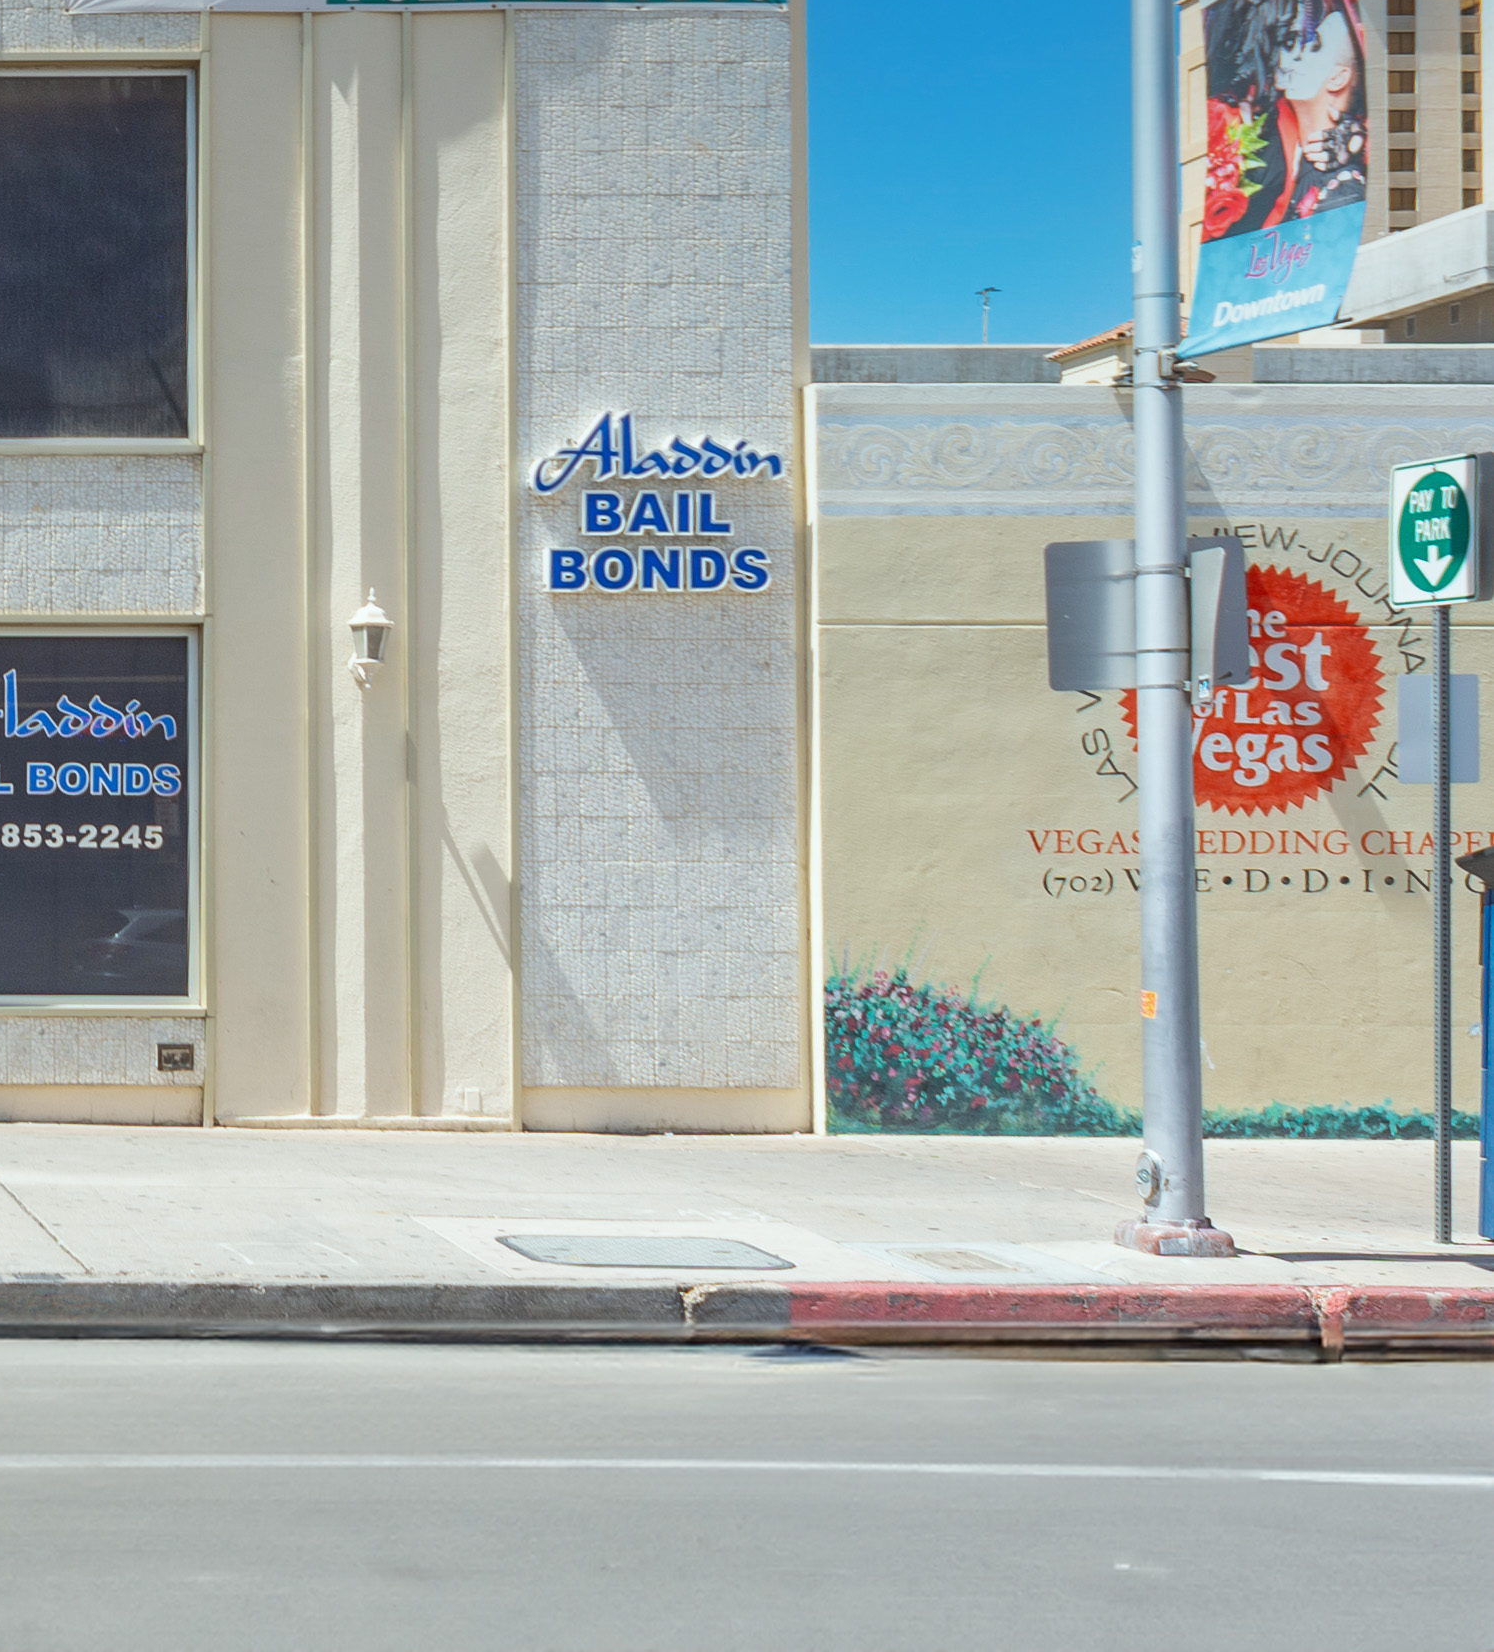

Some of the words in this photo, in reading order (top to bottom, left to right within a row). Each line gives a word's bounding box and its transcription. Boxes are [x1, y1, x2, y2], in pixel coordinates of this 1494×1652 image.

[1245, 245, 1268, 278] Las
[1265, 231, 1313, 284] Vegas
[1213, 284, 1326, 327] Downtown
[531, 410, 783, 494] Aladdin
[582, 490, 734, 535] BAIL
[1408, 488, 1434, 514] PAY
[1440, 485, 1459, 509] TO
[1414, 516, 1452, 542] PARK
[547, 547, 771, 591] BONDS
[1234, 692, 1322, 726] Las
[26, 762, 181, 796] BONDS
[1196, 829, 1350, 855] EDDING
[1361, 829, 1494, 855] CHAPE
[1043, 867, 1114, 898] (702)
